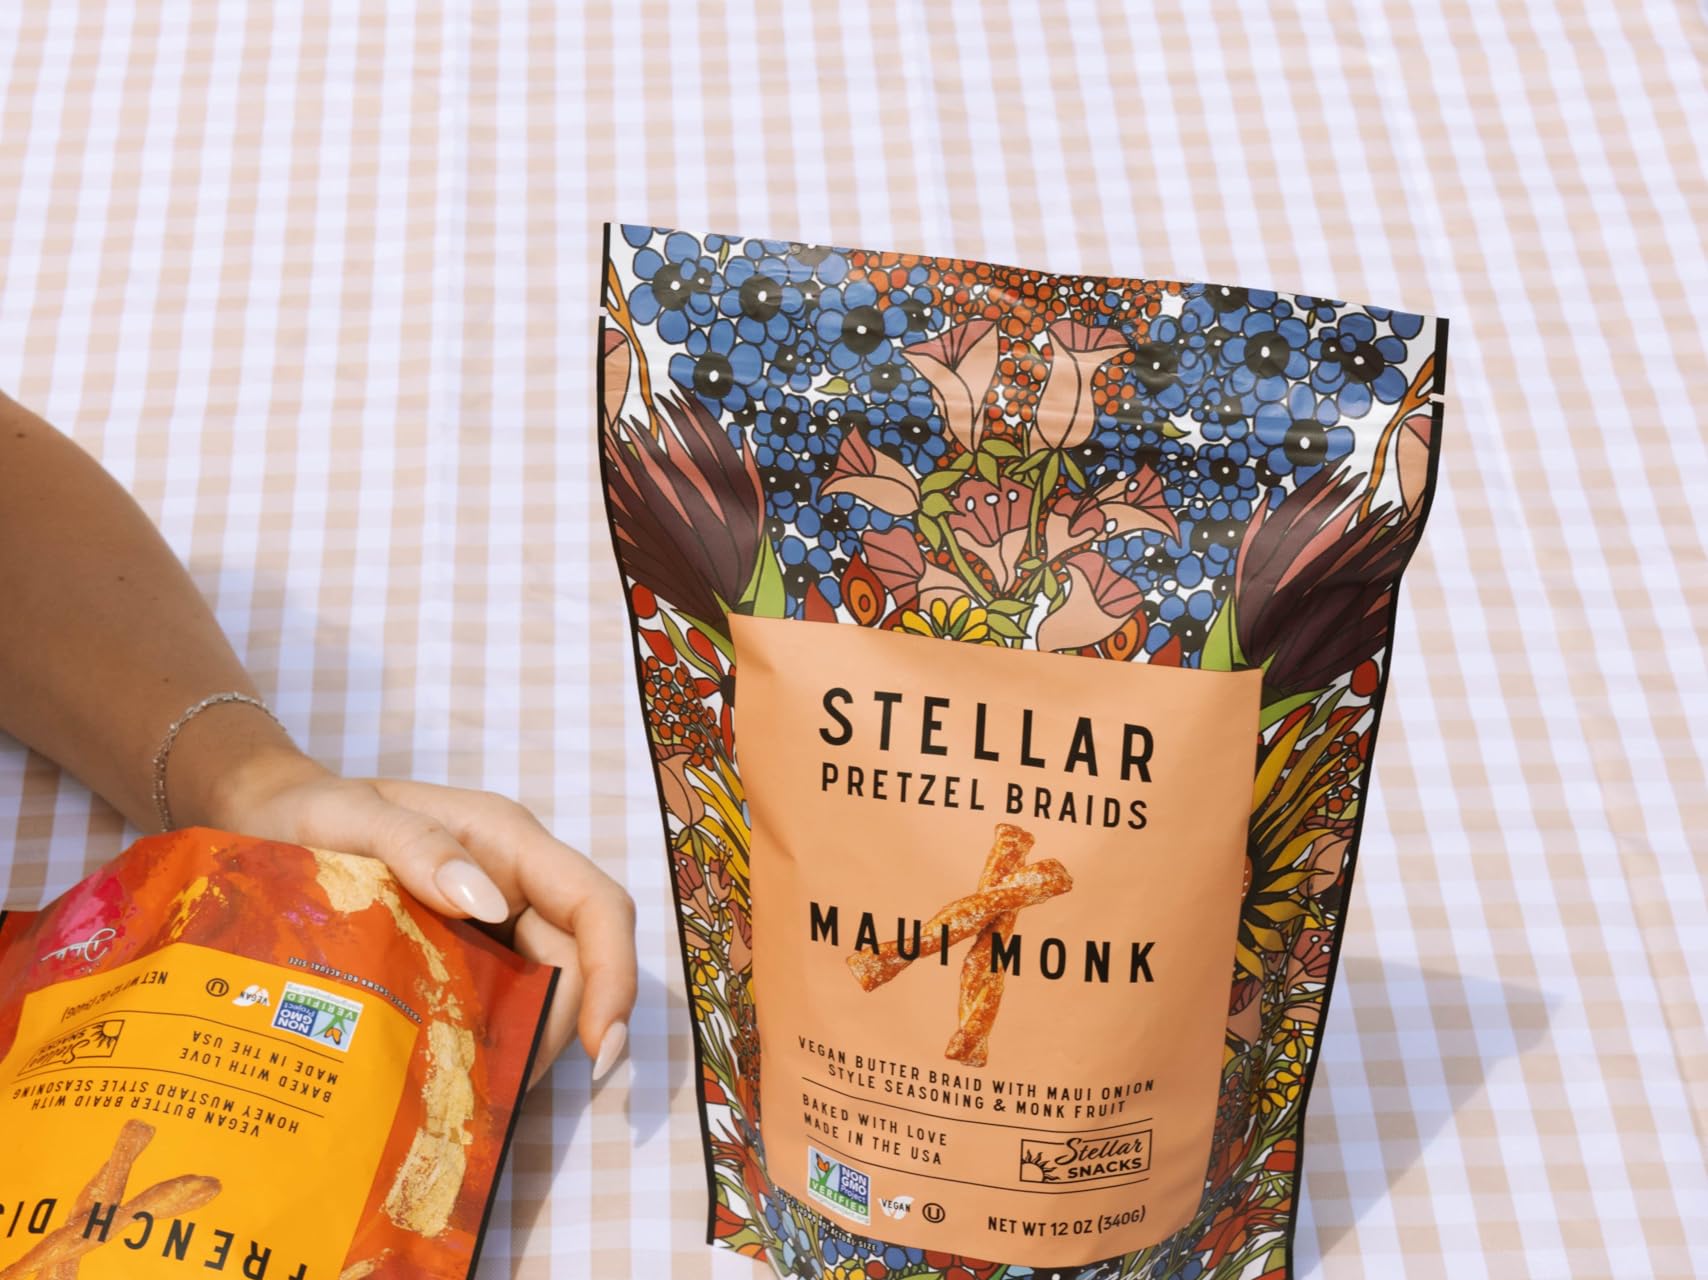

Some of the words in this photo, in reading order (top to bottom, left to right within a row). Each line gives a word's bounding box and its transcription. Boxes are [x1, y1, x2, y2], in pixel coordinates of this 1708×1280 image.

[818, 687, 1154, 783] STELLAR
[821, 762, 985, 811] PRETZEL
[1006, 782, 1148, 830] BRAIDS
[809, 901, 949, 966] MAUI
[990, 932, 1155, 984] MONK
[288, 957, 307, 967] SIZE
[311, 961, 340, 977] ACTUAL
[141, 971, 168, 985] NET
[240, 991, 268, 1005] VEGAN
[286, 993, 353, 1019] VERIFIED
[280, 1008, 312, 1025] GMO
[282, 1003, 315, 1017] Project
[277, 1018, 309, 1034] NON
[192, 1031, 223, 1049] USA
[179, 1047, 221, 1067] LOVE
[232, 1042, 261, 1060] THE
[270, 1053, 287, 1067] IN
[228, 1060, 269, 1081] WITH
[294, 1061, 338, 1085] MADE
[798, 1035, 845, 1064] VEGAN
[856, 1055, 919, 1080] BUTTER
[929, 1071, 982, 1091] BRAID
[992, 1080, 1036, 1098] WITH
[1047, 1086, 1091, 1101] MAUI
[1101, 1079, 1153, 1100] ONION
[12, 1079, 93, 1099] SEASONING
[100, 1080, 149, 1093] STYLE
[279, 1076, 332, 1103] BAKED
[828, 1064, 876, 1089] STYLE
[885, 1079, 983, 1109] SEASONING
[993, 1098, 1006, 1112] &
[1016, 1101, 1064, 1118] MONK
[1074, 1100, 1125, 1118] FRUIT
[31, 1095, 66, 1110] WITH
[74, 1095, 123, 1108] BRAID
[131, 1097, 196, 1119] BUTTER
[156, 1083, 235, 1112] MUSTARD
[204, 1111, 260, 1137] VEGAN
[242, 1105, 299, 1134] HONEY
[802, 1094, 849, 1121] BAKED
[858, 1113, 897, 1134] WITH
[907, 1125, 947, 1146] LOVE
[804, 1112, 839, 1139] MADE
[848, 1130, 863, 1146] IN
[872, 1136, 901, 1156] THE
[911, 1146, 941, 1165] USA
[1055, 1137, 1143, 1166] Stellar
[841, 1166, 867, 1186] NON
[1068, 1157, 1142, 1178] SNACKS
[841, 1176, 867, 1195] GMO
[811, 1180, 866, 1214] VERIFIED
[881, 1199, 911, 1213] VEGAN
[0, 1198, 58, 1238] DI
[988, 1216, 1017, 1234] NET
[1022, 1221, 1046, 1237] WT
[1050, 1222, 1068, 1236] 12
[1073, 1219, 1092, 1234] OZ
[1097, 1205, 1146, 1234] (340G)
[830, 1228, 855, 1245] ACTUAL
[859, 1241, 876, 1251] SIZE
